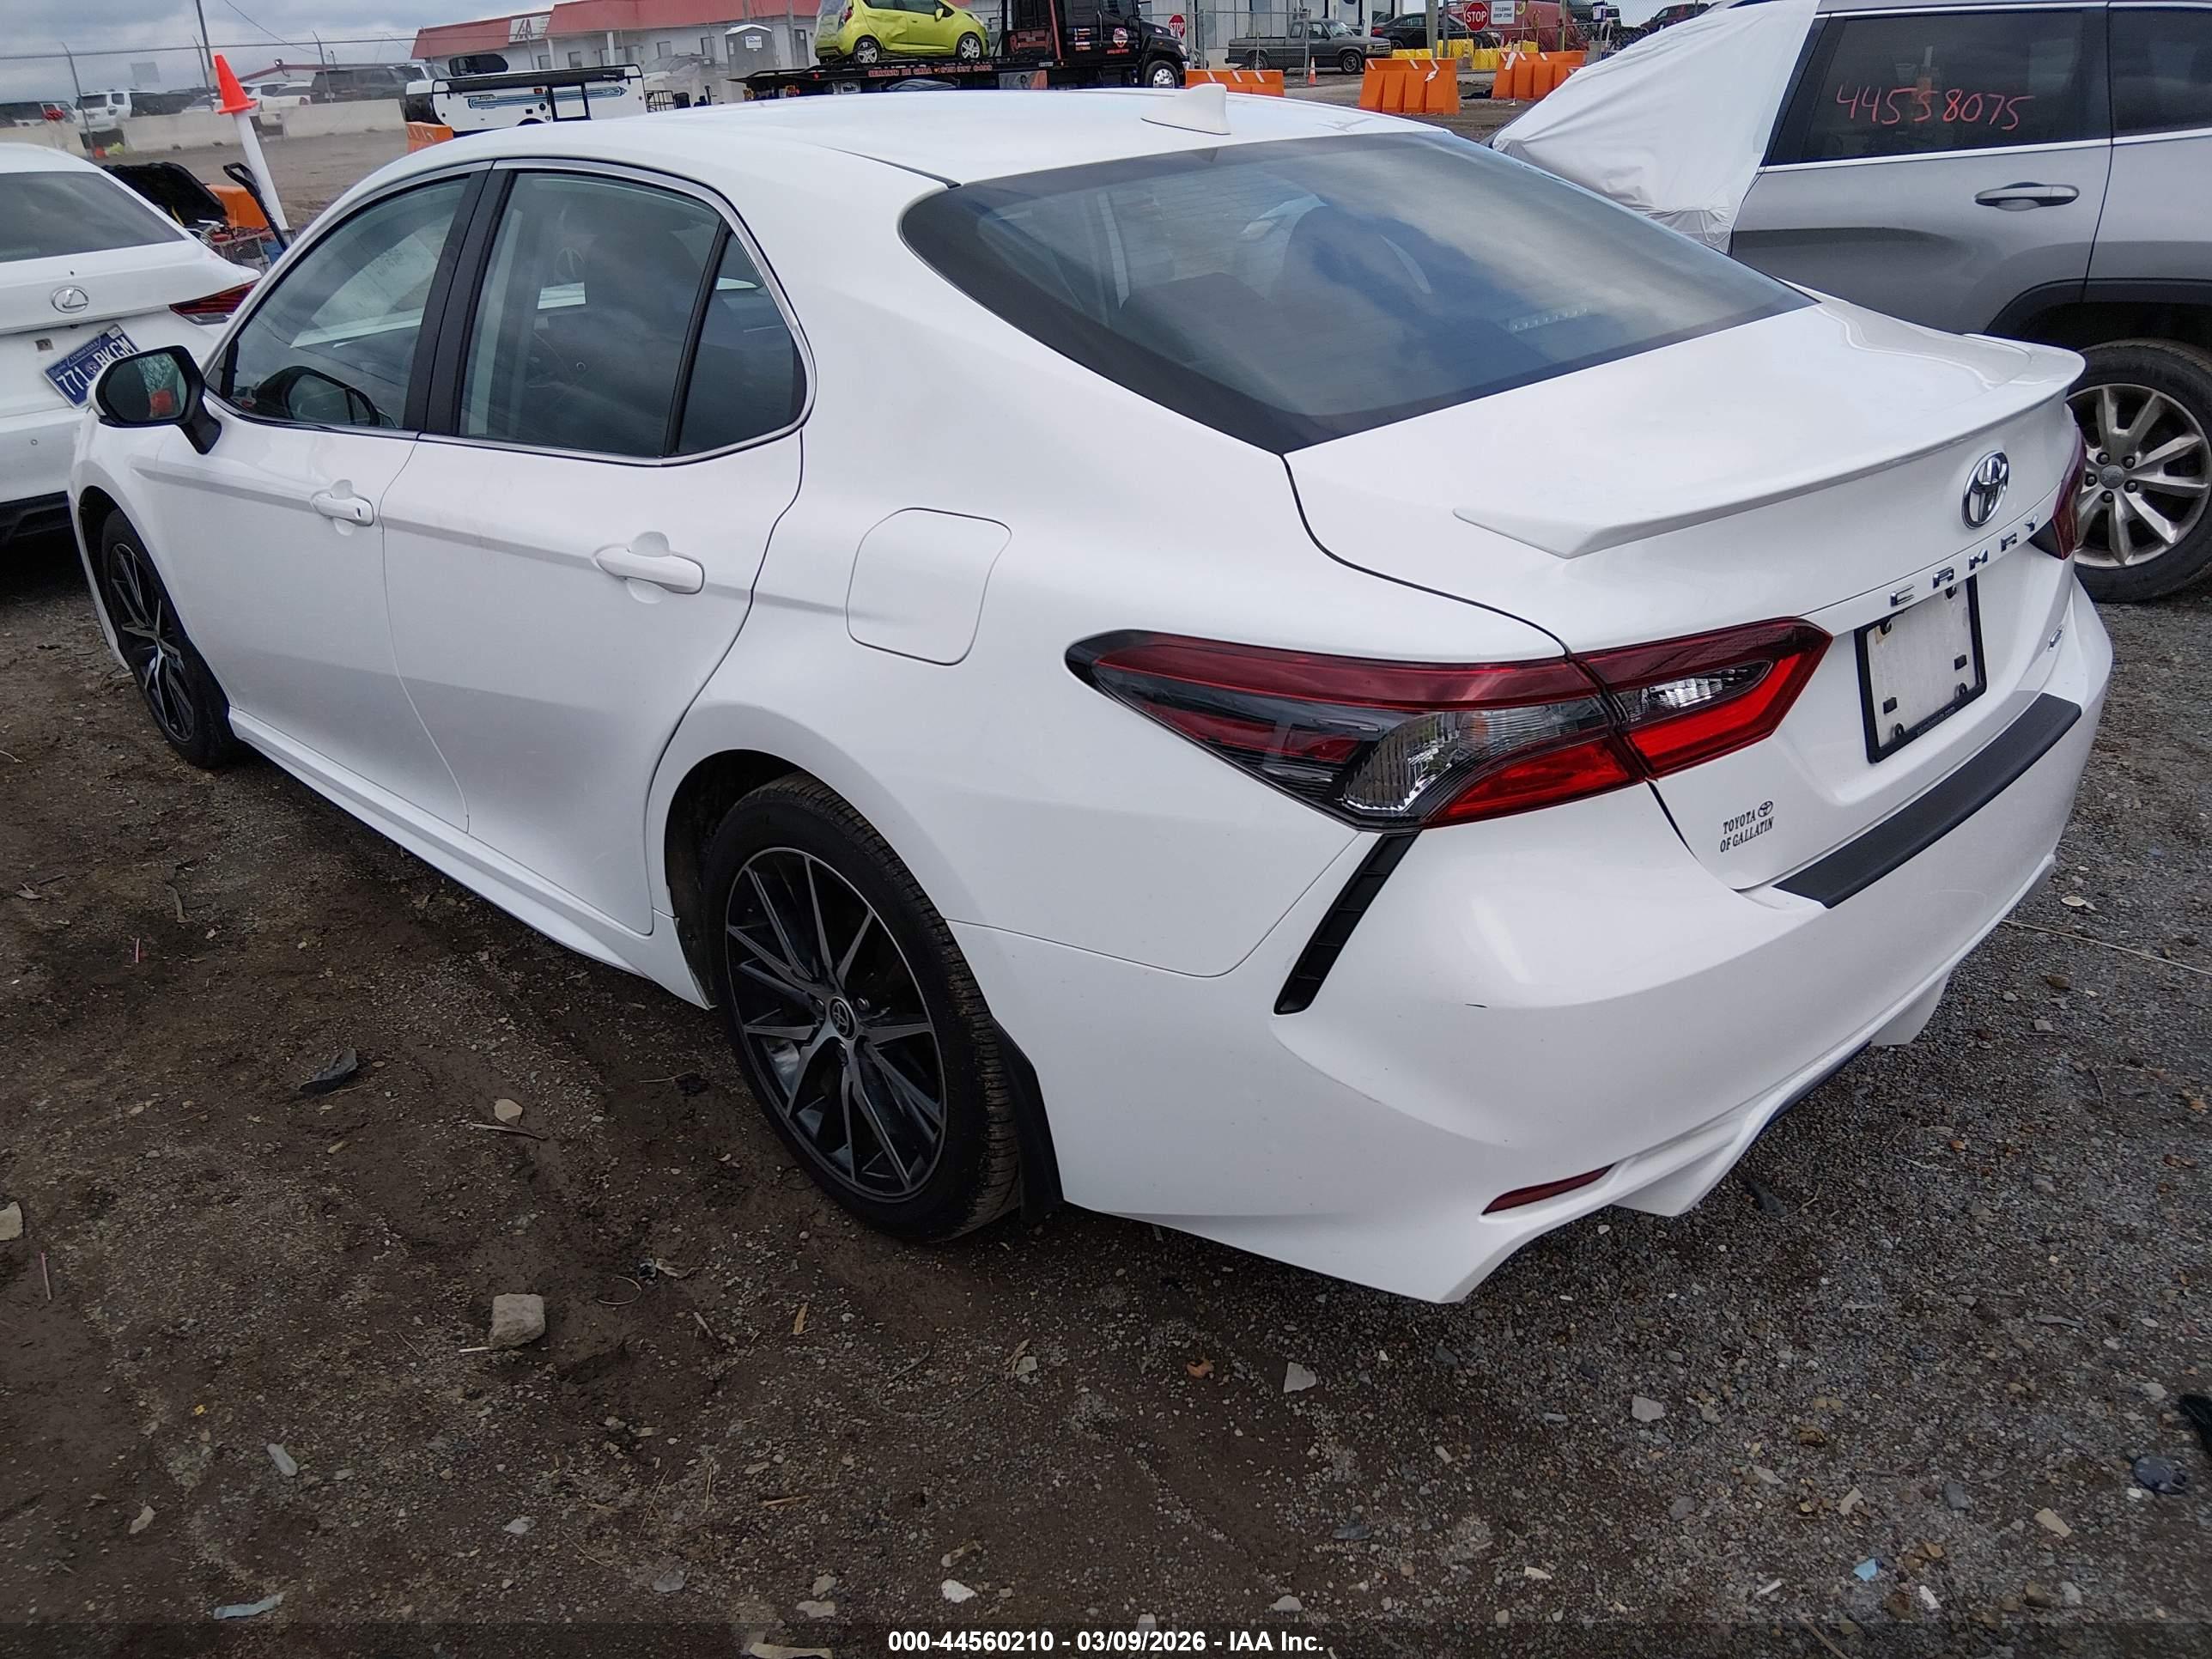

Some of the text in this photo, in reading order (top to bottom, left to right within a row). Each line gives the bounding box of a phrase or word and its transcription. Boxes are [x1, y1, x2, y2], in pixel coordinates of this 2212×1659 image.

[1170, 22, 1185, 33] STOP
[1467, 10, 1487, 23] STOP
[56, 366, 90, 396] 771
[1720, 816, 1775, 853] OF GALLATIN
[1723, 809, 1756, 835] TOYOTA
